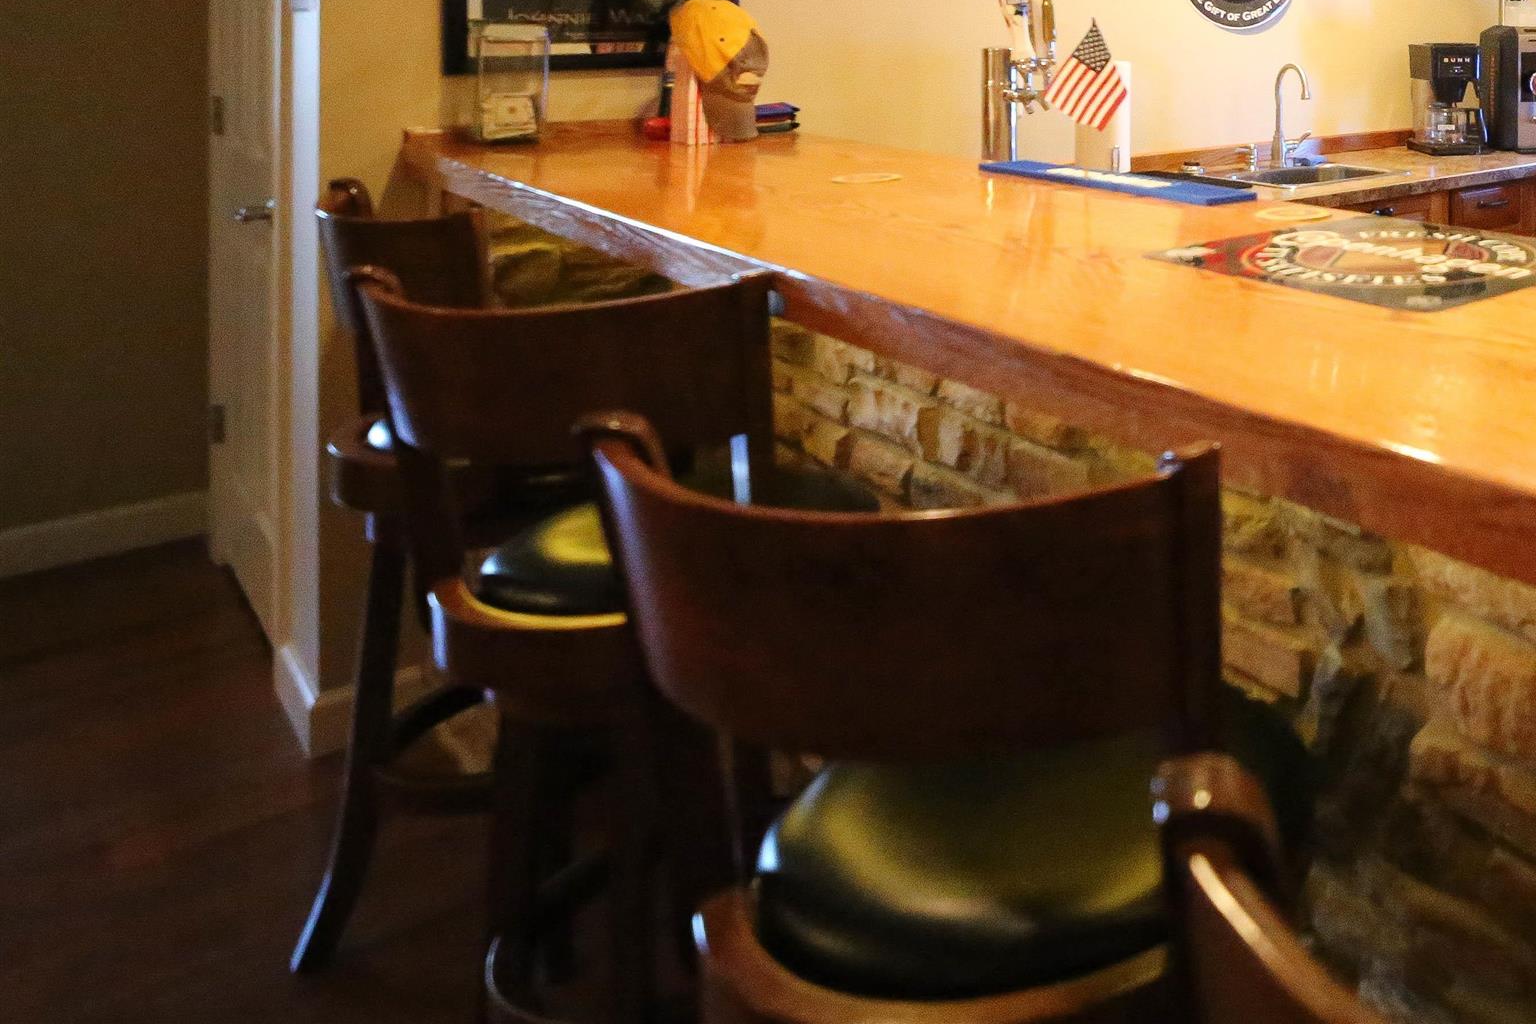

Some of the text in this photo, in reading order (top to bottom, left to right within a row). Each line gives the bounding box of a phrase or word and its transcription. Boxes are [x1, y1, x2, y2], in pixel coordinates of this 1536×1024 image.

[1204, 1, 1227, 20] GIFT
[1227, 13, 1240, 21] OF
[1242, 2, 1273, 21] GREAT
